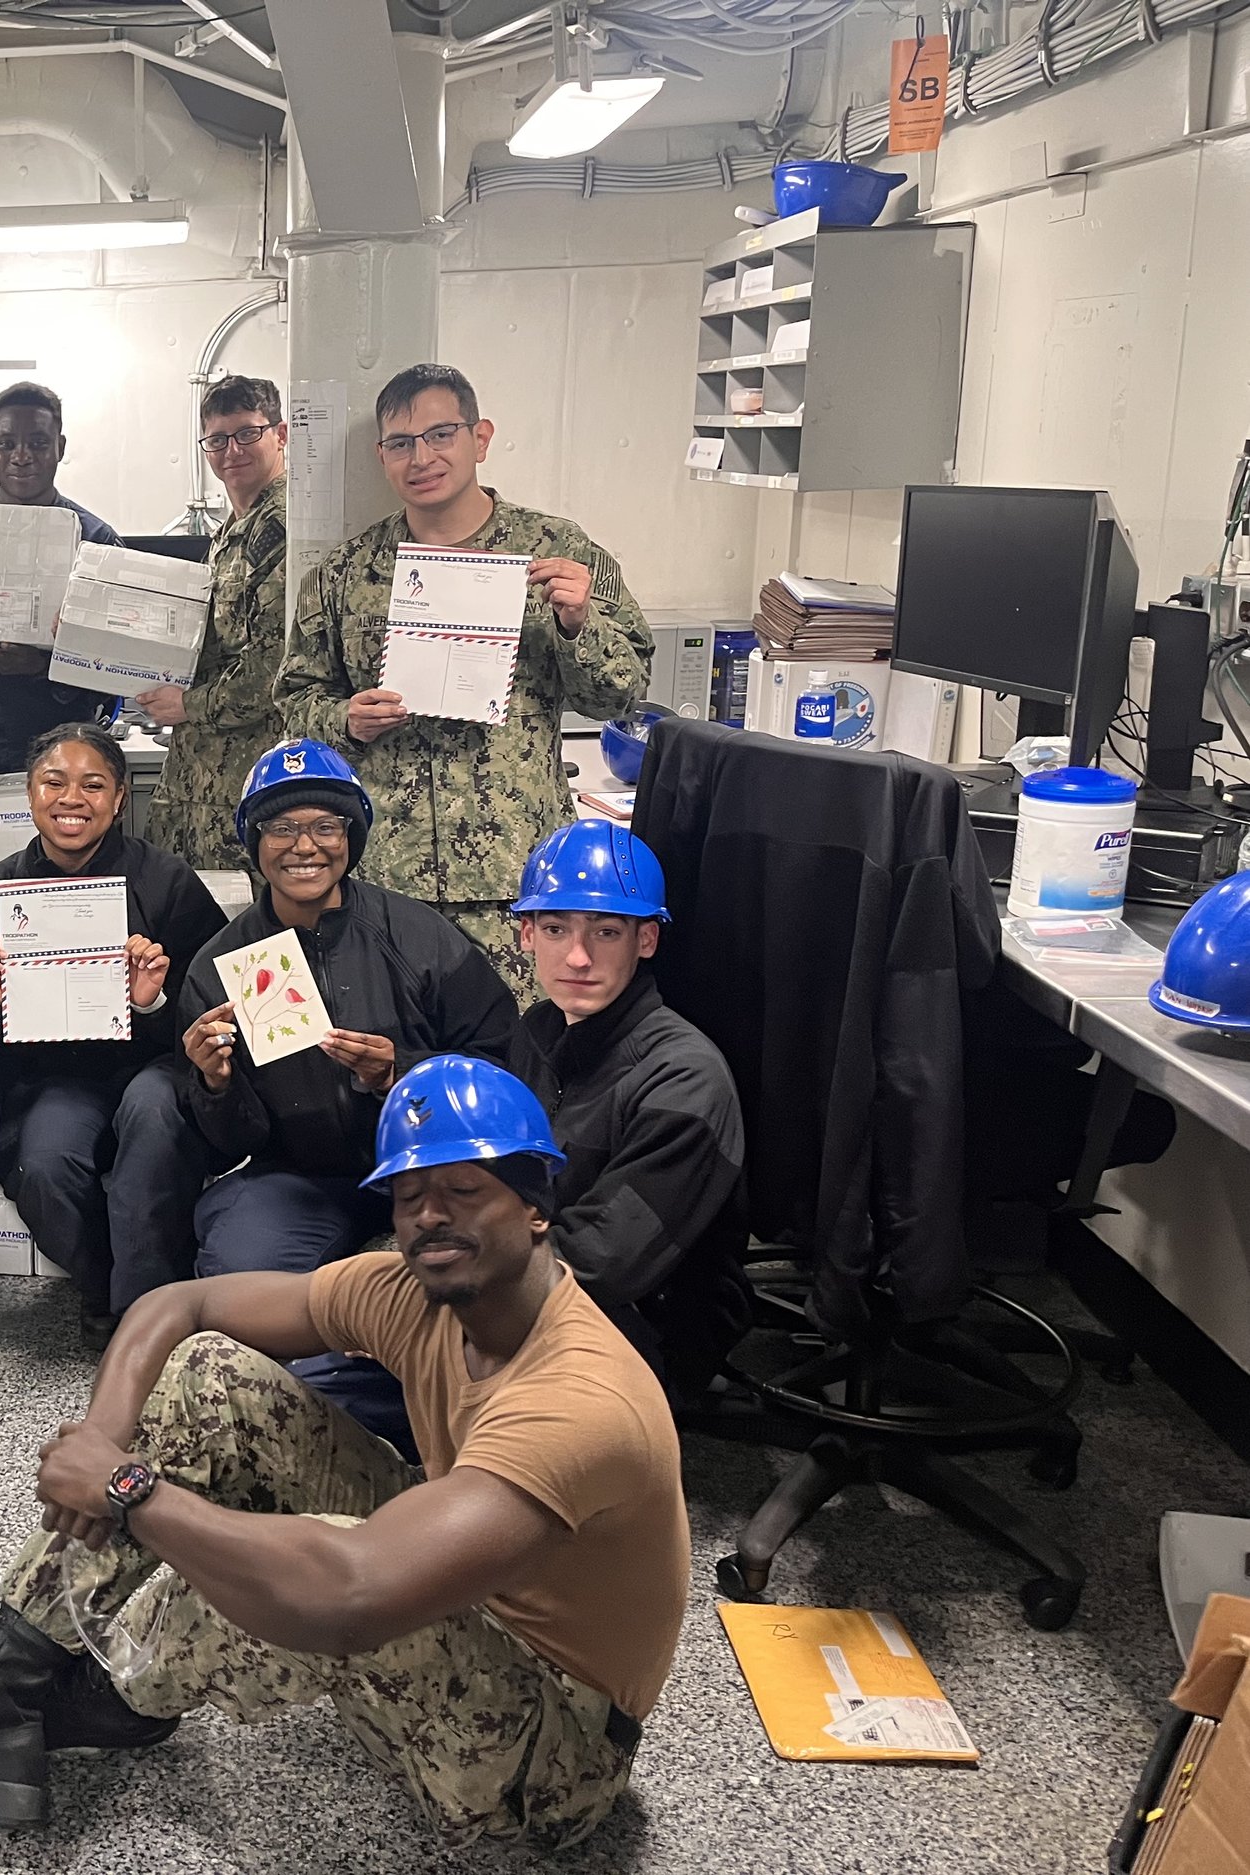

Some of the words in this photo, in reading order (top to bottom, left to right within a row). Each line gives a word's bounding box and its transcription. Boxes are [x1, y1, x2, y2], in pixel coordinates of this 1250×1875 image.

[899, 77, 940, 102] SB
[393, 598, 430, 607] TROOPATHON
[525, 602, 545, 614] AVY
[357, 613, 388, 628] ALVER
[105, 666, 161, 682] TROOPATHON
[0, 812, 32, 820] TROOPA
